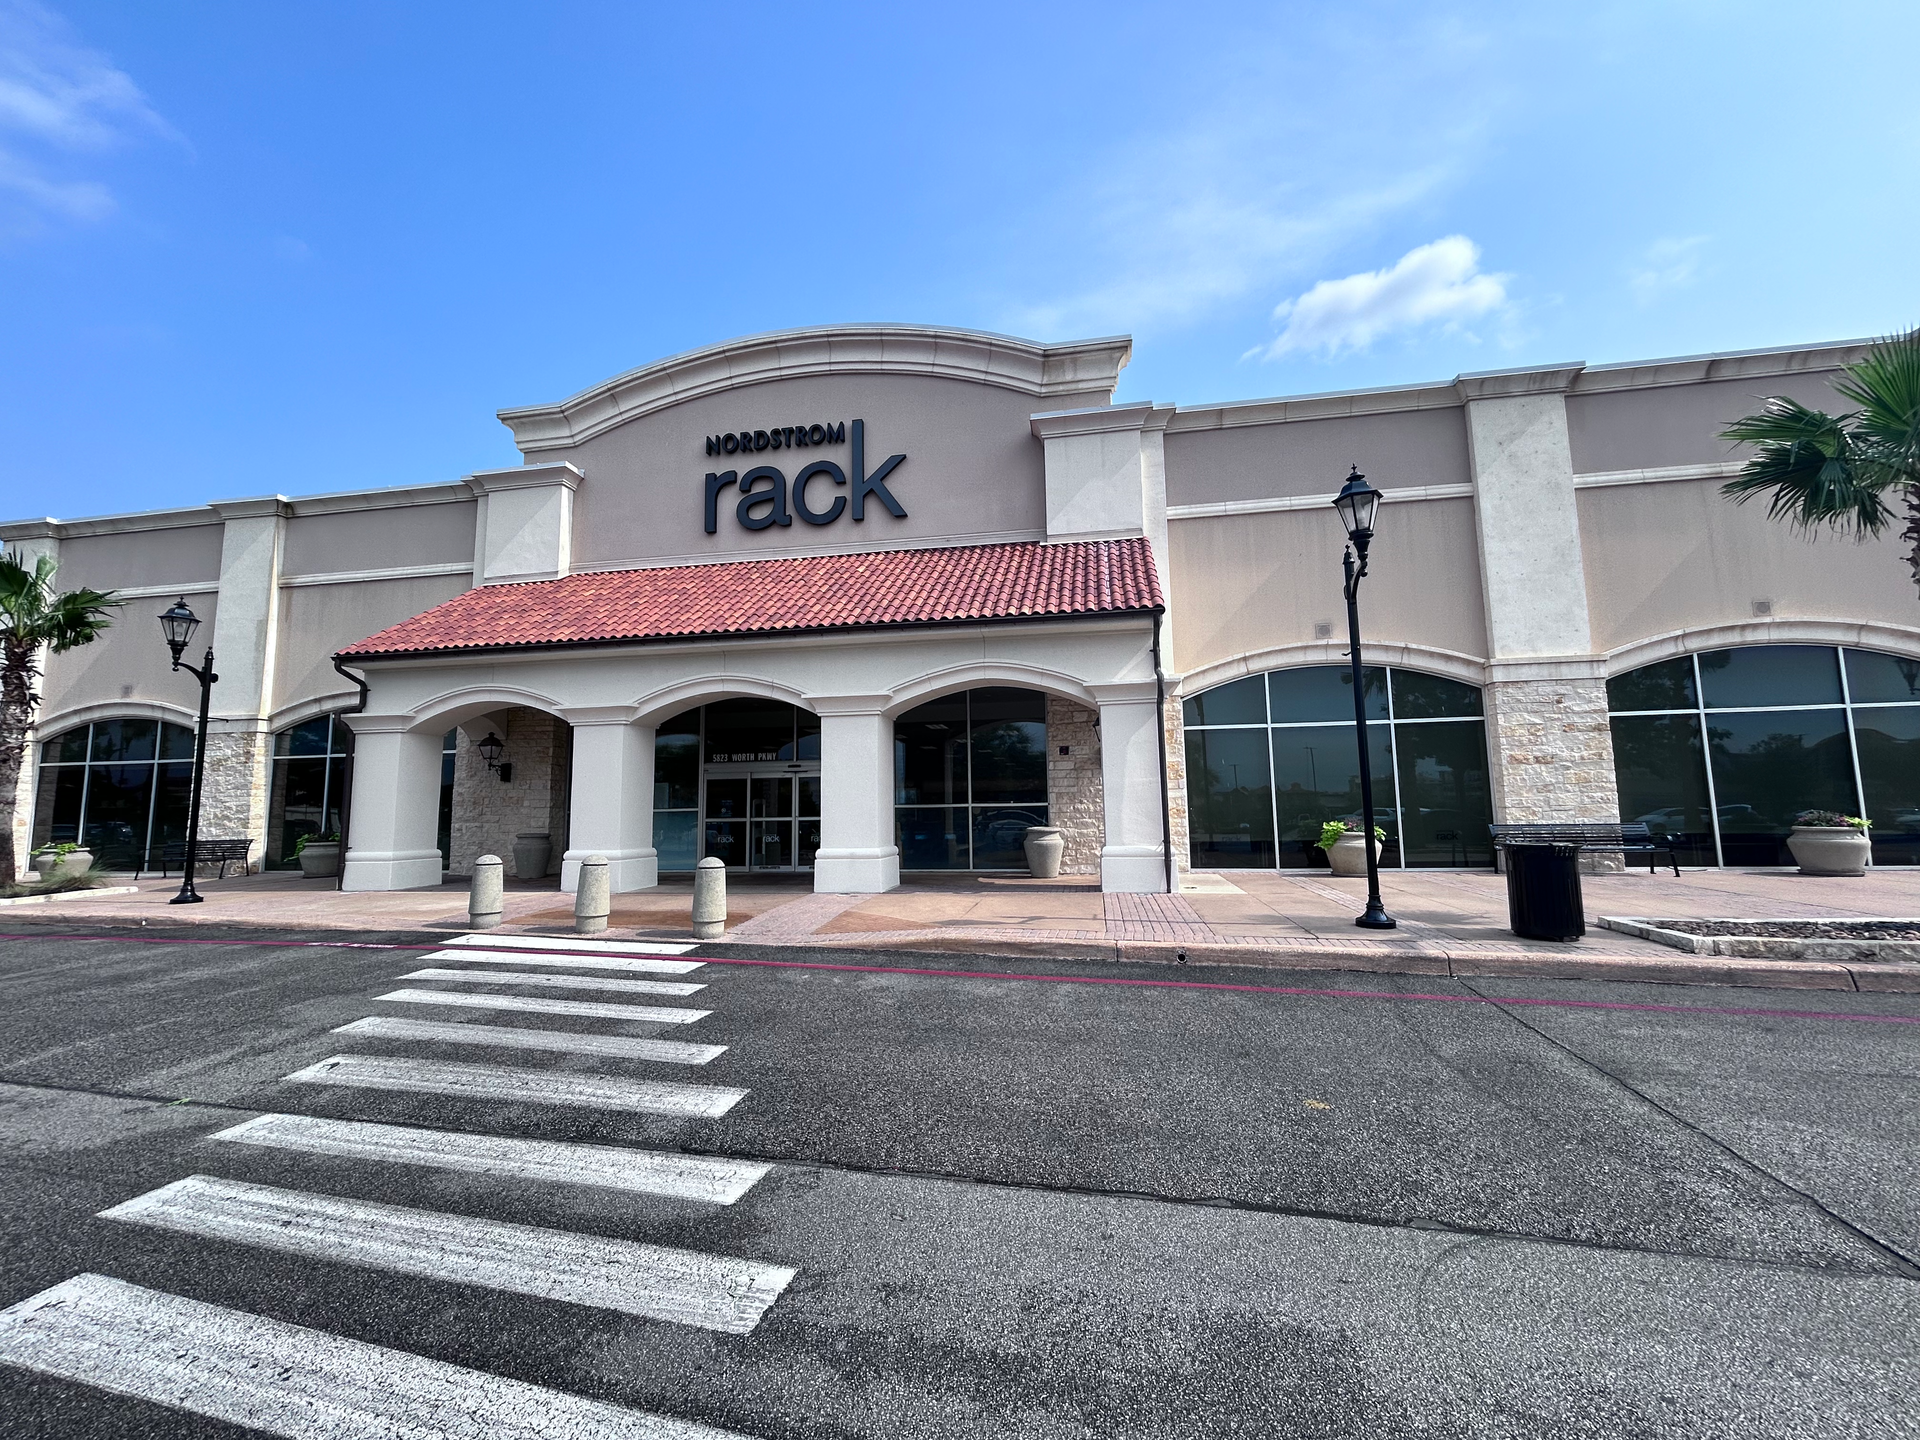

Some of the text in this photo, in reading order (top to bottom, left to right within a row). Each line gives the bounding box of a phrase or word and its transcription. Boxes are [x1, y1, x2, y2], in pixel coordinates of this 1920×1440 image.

[706, 421, 846, 456] NORDSTROM
[704, 419, 908, 534] rack
[712, 752, 777, 762] 5823 WORTH PKWY
[717, 834, 735, 843] rack
[762, 834, 780, 843] rack
[810, 834, 821, 842] ra
[1436, 830, 1458, 840] rack
